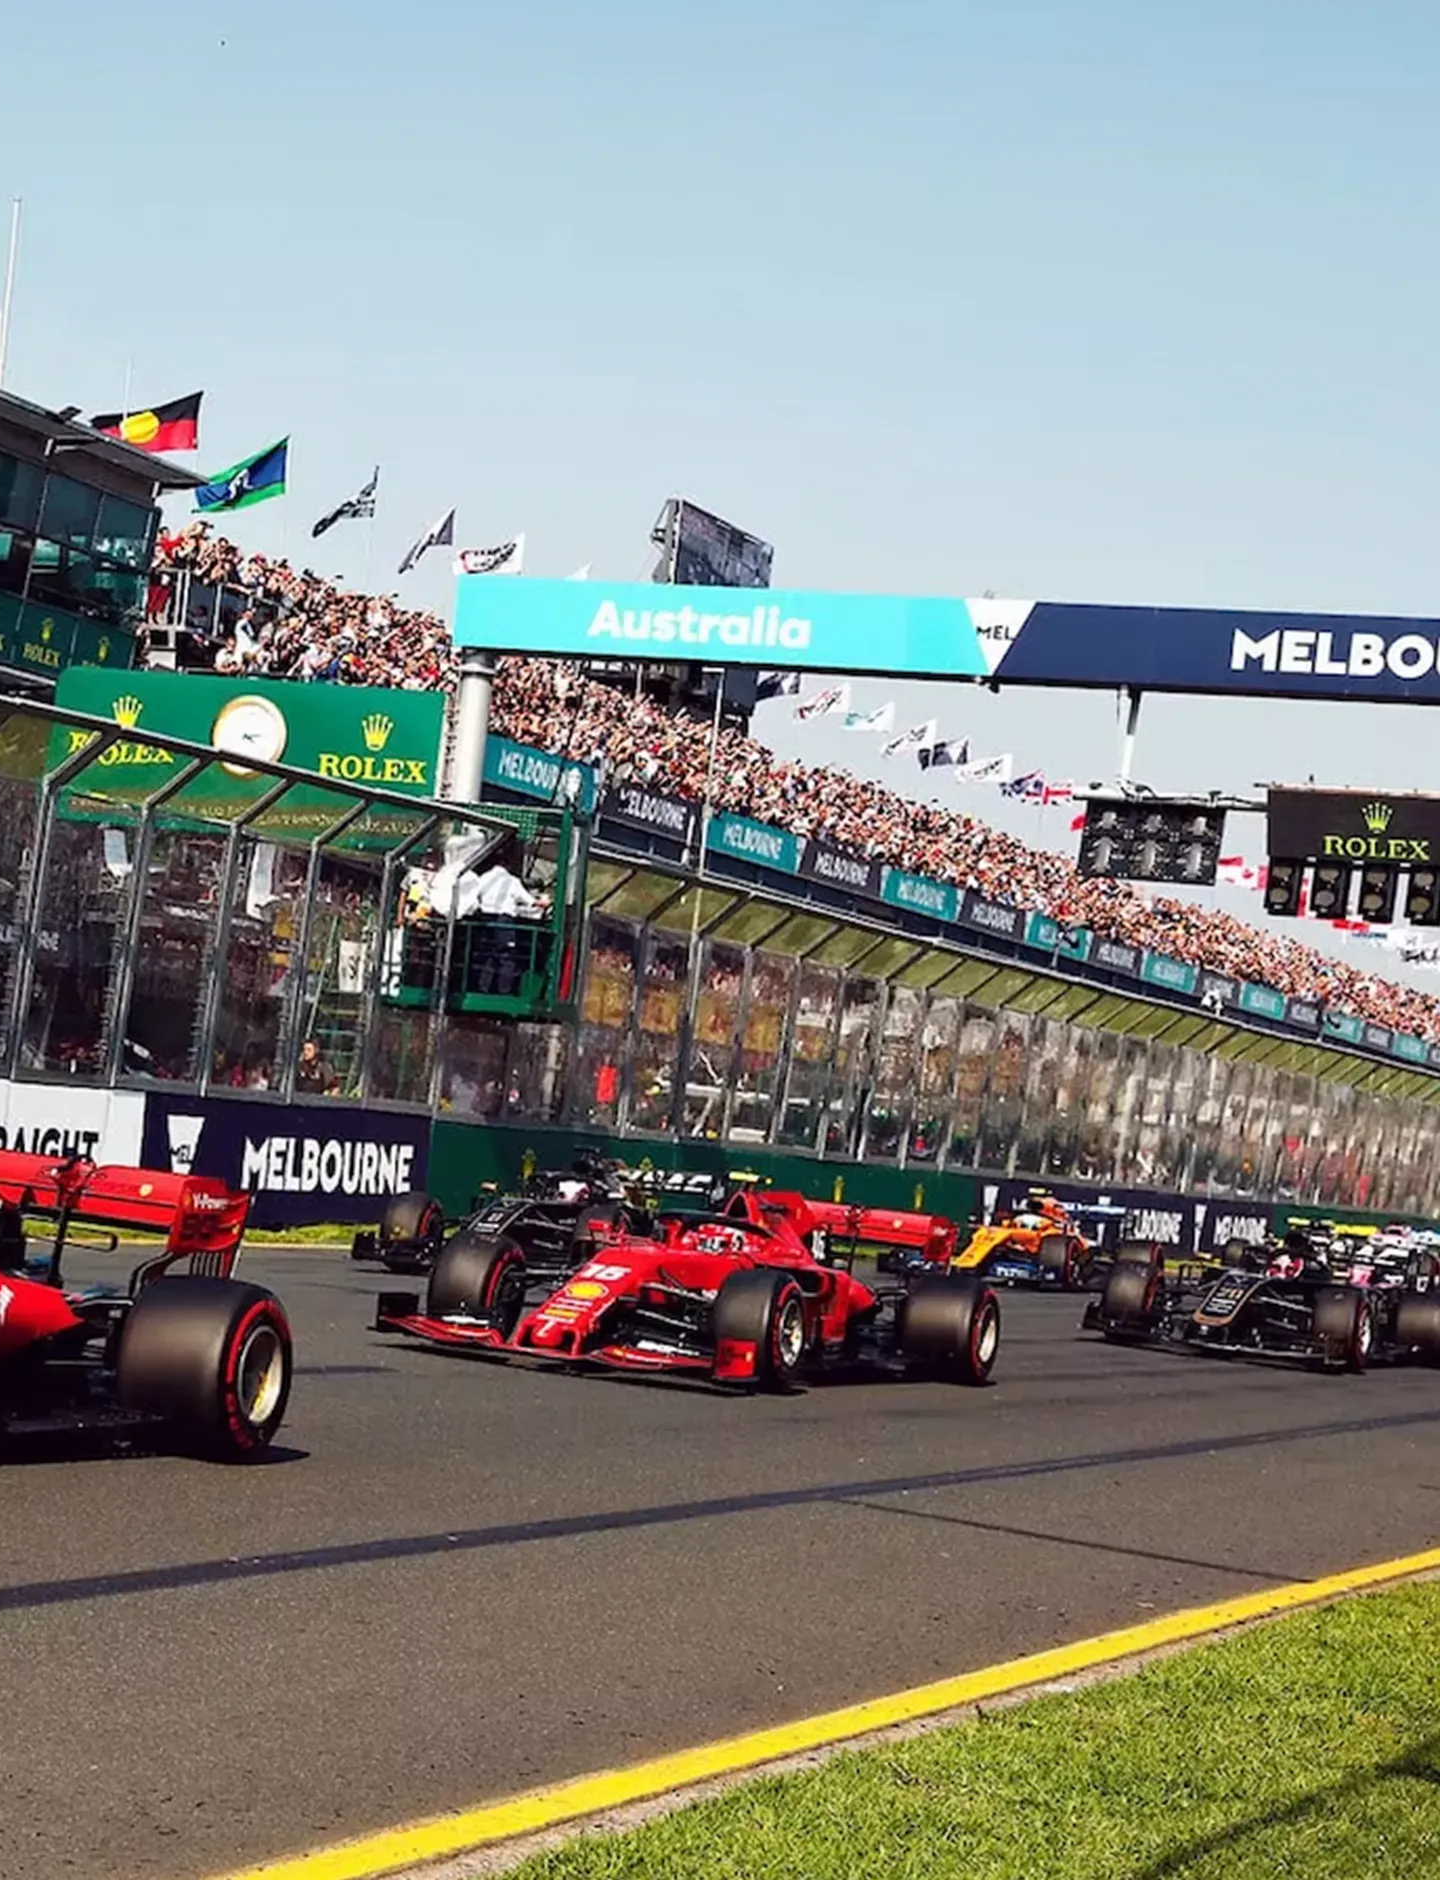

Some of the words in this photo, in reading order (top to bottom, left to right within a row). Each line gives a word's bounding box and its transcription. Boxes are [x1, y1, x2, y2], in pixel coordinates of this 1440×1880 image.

[588, 600, 811, 649] Australia
[1230, 628, 1440, 679] MELBO
[318, 753, 427, 785] ROLEX
[1323, 834, 1430, 861] ROLEX
[240, 1135, 414, 1194] MELBOURNE
